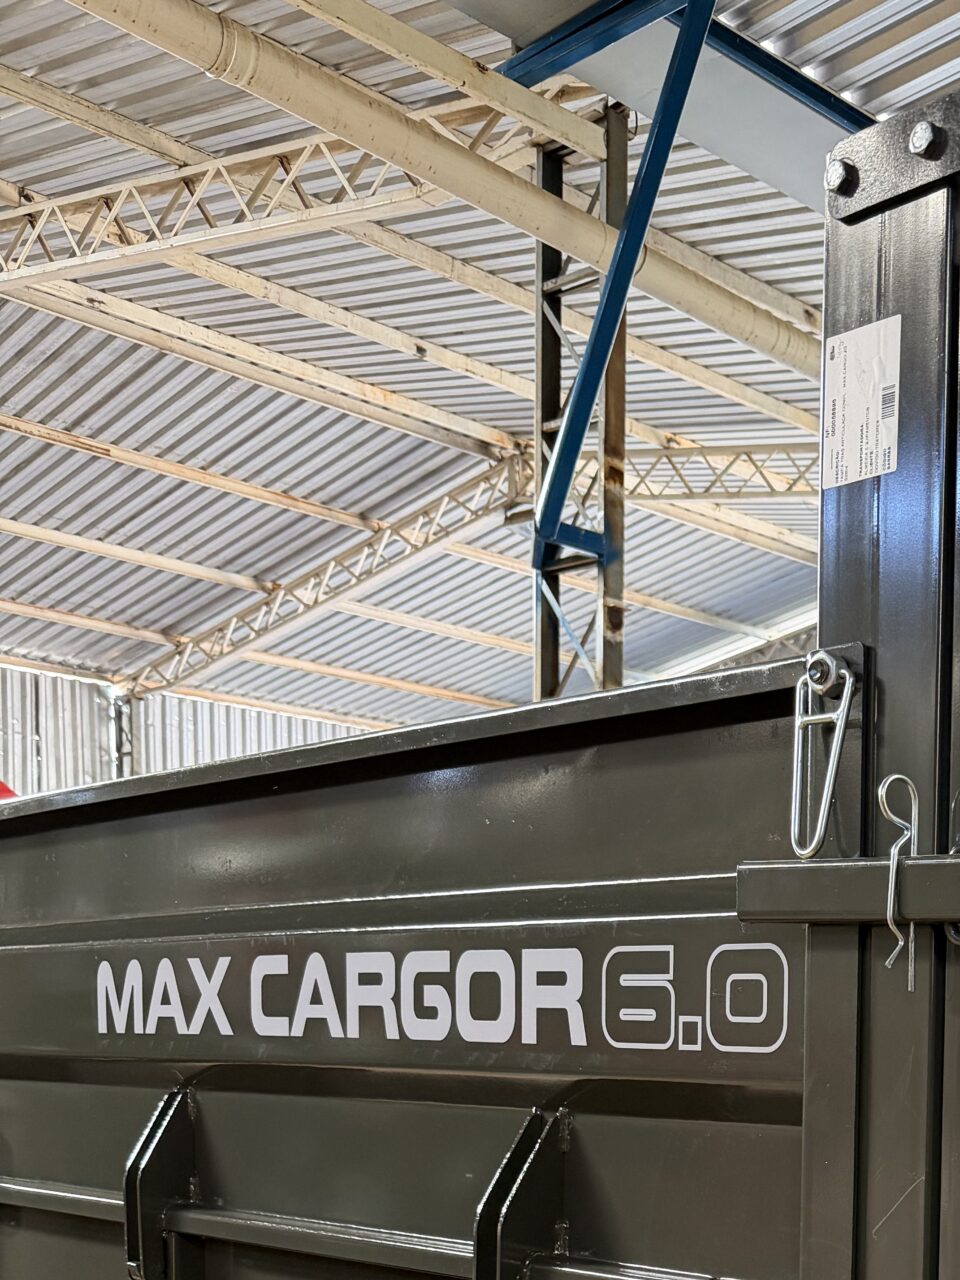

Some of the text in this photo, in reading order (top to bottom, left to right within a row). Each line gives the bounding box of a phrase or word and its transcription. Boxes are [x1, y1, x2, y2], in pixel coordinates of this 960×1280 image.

[97, 942, 789, 1054] MAX CARGOR 6.0
